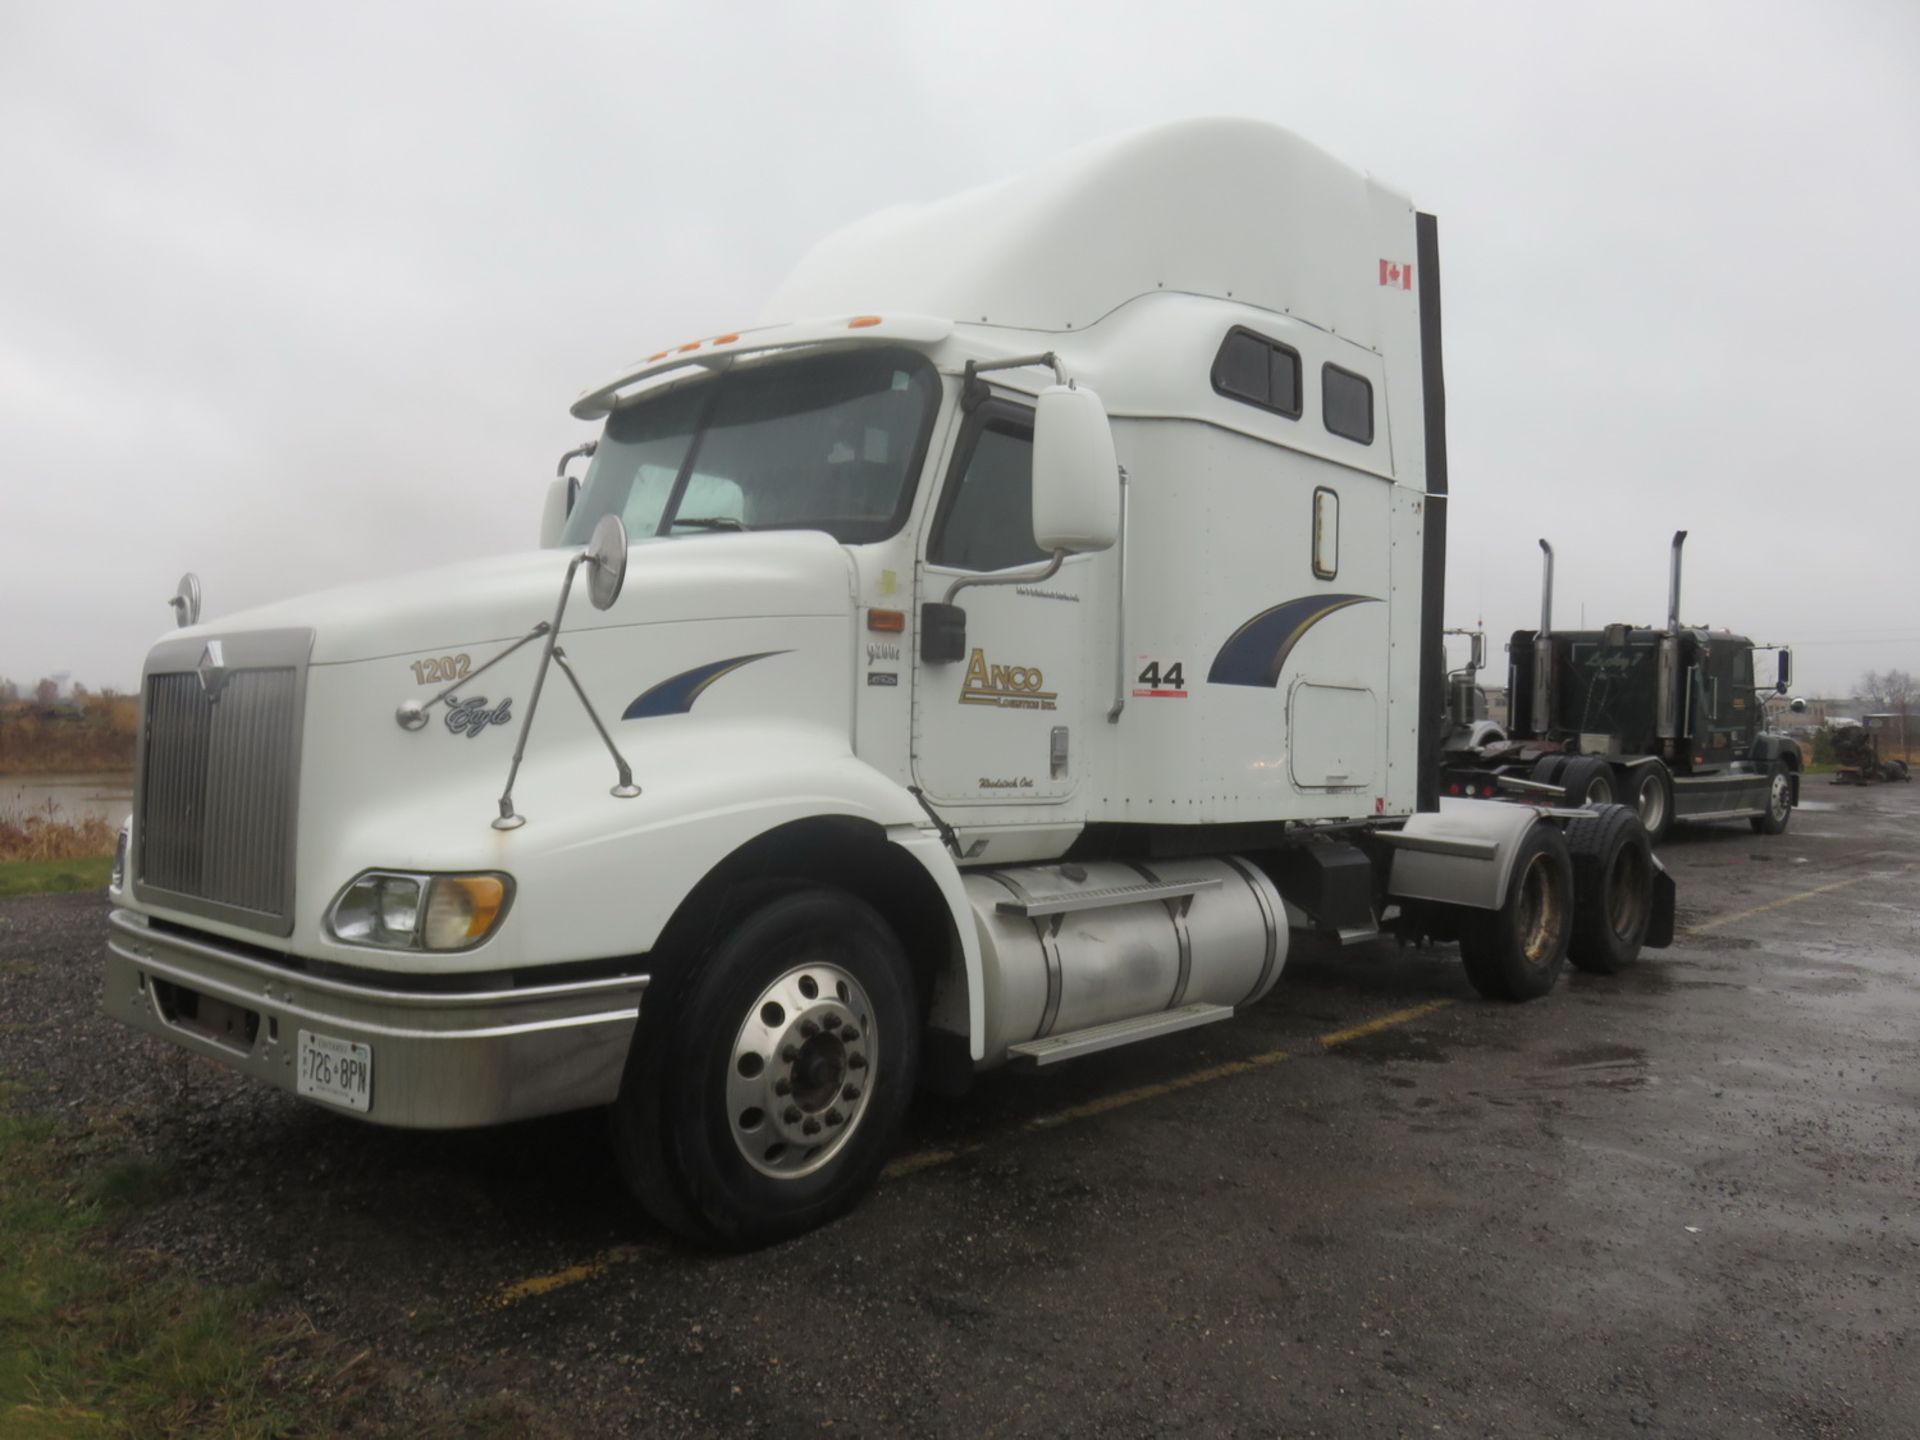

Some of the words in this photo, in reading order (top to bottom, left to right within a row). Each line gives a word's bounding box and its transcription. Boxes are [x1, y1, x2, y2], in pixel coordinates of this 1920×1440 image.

[410, 653, 472, 685] 1202
[1138, 661, 1184, 689] 44
[444, 695, 512, 738] Eagle
[308, 1048, 331, 1085] 726
[340, 1057, 367, 1095] 8PN
